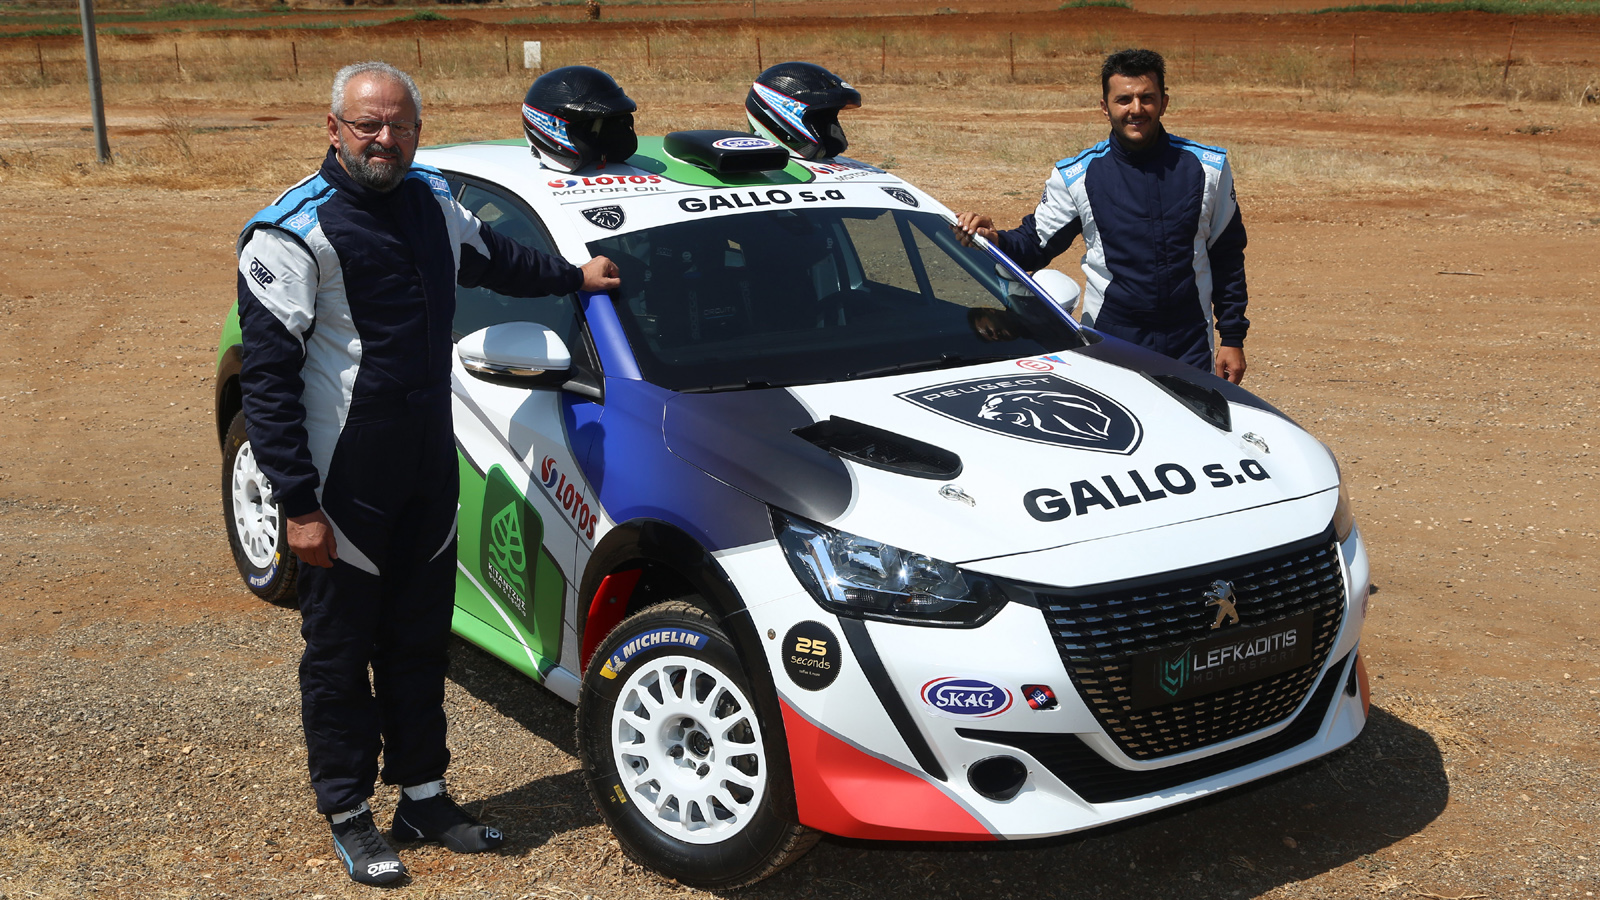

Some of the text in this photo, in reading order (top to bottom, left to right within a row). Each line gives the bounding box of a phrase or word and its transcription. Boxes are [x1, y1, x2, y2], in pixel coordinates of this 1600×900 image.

[1202, 151, 1222, 162] OMP
[581, 175, 661, 187] LOTOS
[1065, 163, 1083, 178] OMP
[552, 186, 628, 196] MOTOR
[678, 189, 845, 213] GALLO s.a
[583, 206, 618, 214] PEUGEOT
[290, 213, 312, 229] OMP
[250, 260, 274, 285] OMP
[922, 378, 1051, 402] PEUGEOT
[1023, 459, 1272, 522] GALLO s.a
[555, 472, 597, 540] LOTOS
[622, 631, 700, 659] MICHELIN
[795, 637, 827, 656] 25
[1193, 629, 1297, 671] LEFKADITIS
[790, 655, 831, 670] seconds
[1193, 650, 1296, 684] MOTORSPORT
[936, 685, 995, 708] SKAG
[367, 863, 400, 875] OMP
